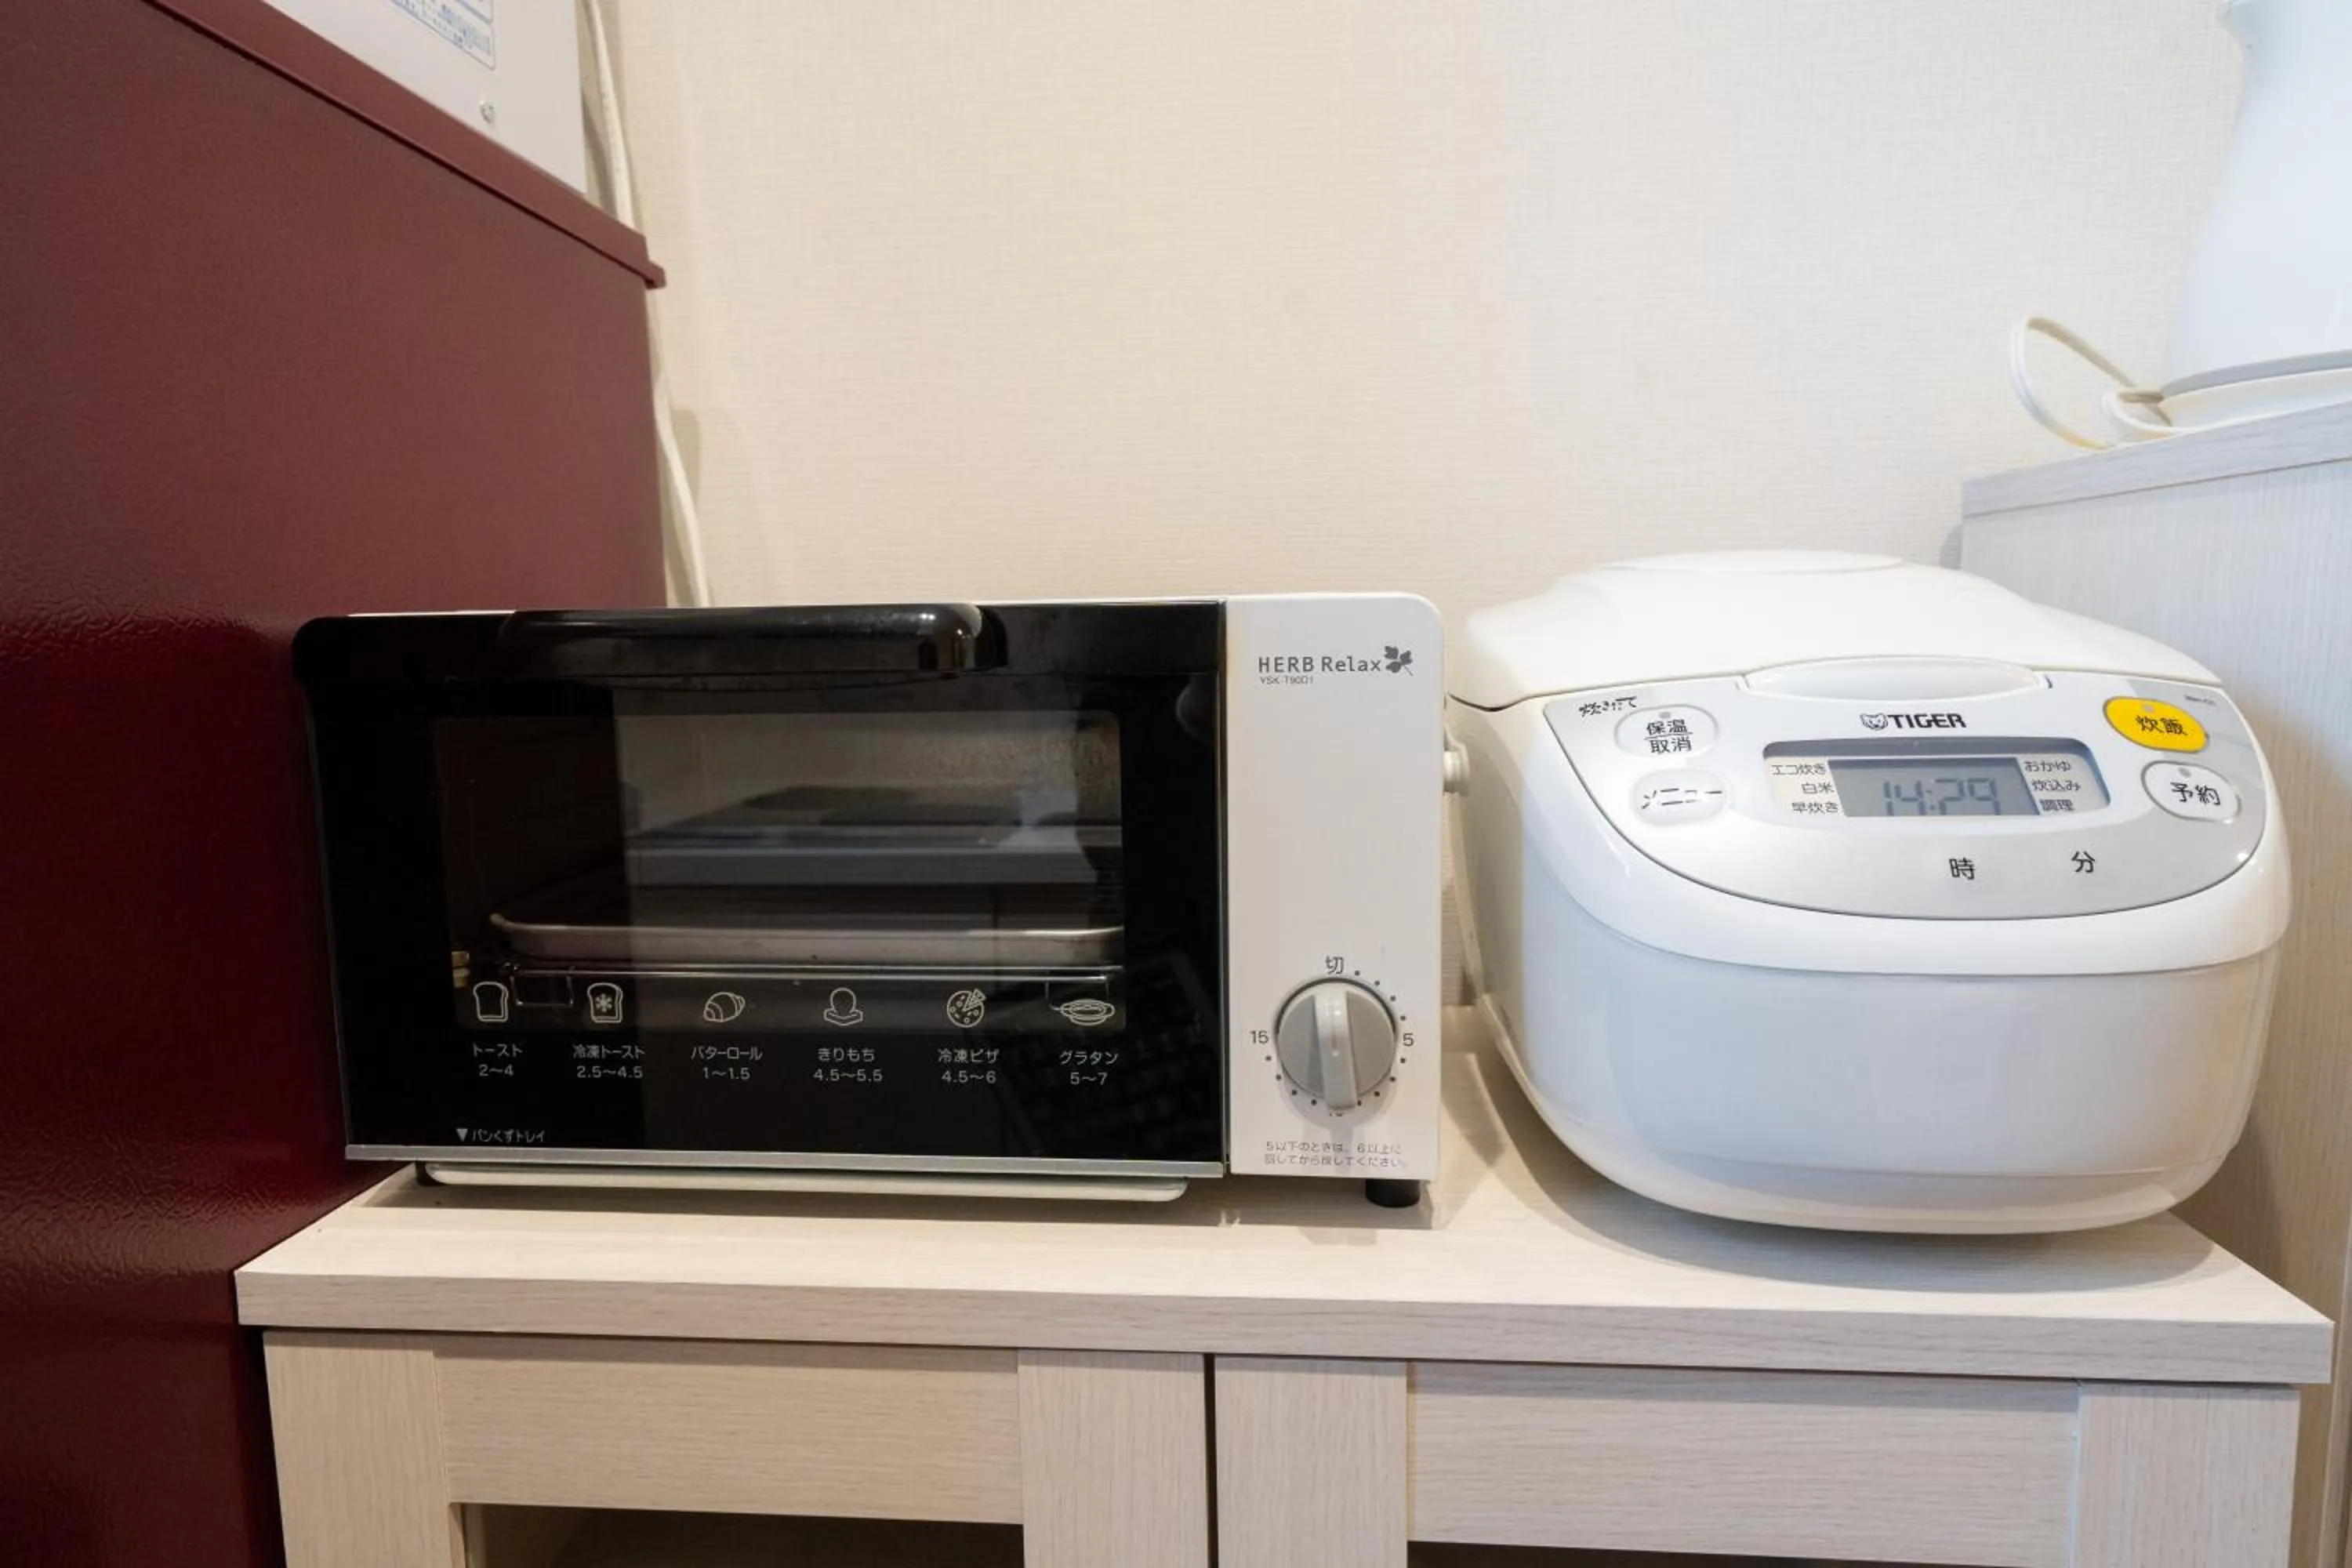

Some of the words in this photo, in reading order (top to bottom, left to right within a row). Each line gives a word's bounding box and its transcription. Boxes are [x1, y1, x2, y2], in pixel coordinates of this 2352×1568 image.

[1258, 655, 1314, 673] HERB
[1321, 655, 1381, 673] Relax
[1646, 718, 1687, 736] 保温
[1886, 713, 1967, 729] TIGER
[2136, 714, 2189, 737] 炊飯
[1650, 737, 1692, 754] 取消
[1771, 763, 1826, 775] エコ炊き
[2024, 760, 2071, 772] おかゆ
[1802, 782, 1835, 794] 白米
[2170, 782, 2221, 806] 予約
[1641, 787, 1723, 810] メニュー
[1883, 778, 2002, 816] 14:29
[2040, 798, 2074, 811] 調理
[1791, 800, 1839, 814] 早炊き
[1948, 857, 1975, 880] 時
[2071, 851, 2096, 874] 分
[1325, 956, 1344, 975] 切
[1250, 1029, 1269, 1045] 15
[1402, 1033, 1414, 1047] 5
[472, 1044, 524, 1058] トースト
[572, 1044, 645, 1059] 冷凍トースト
[690, 1046, 763, 1061] バターロール
[816, 1047, 876, 1062] きりもち
[938, 1048, 1000, 1064] 冷凍ピザ
[1058, 1050, 1120, 1065] グラタン
[471, 1128, 547, 1143] パンくずトレイ
